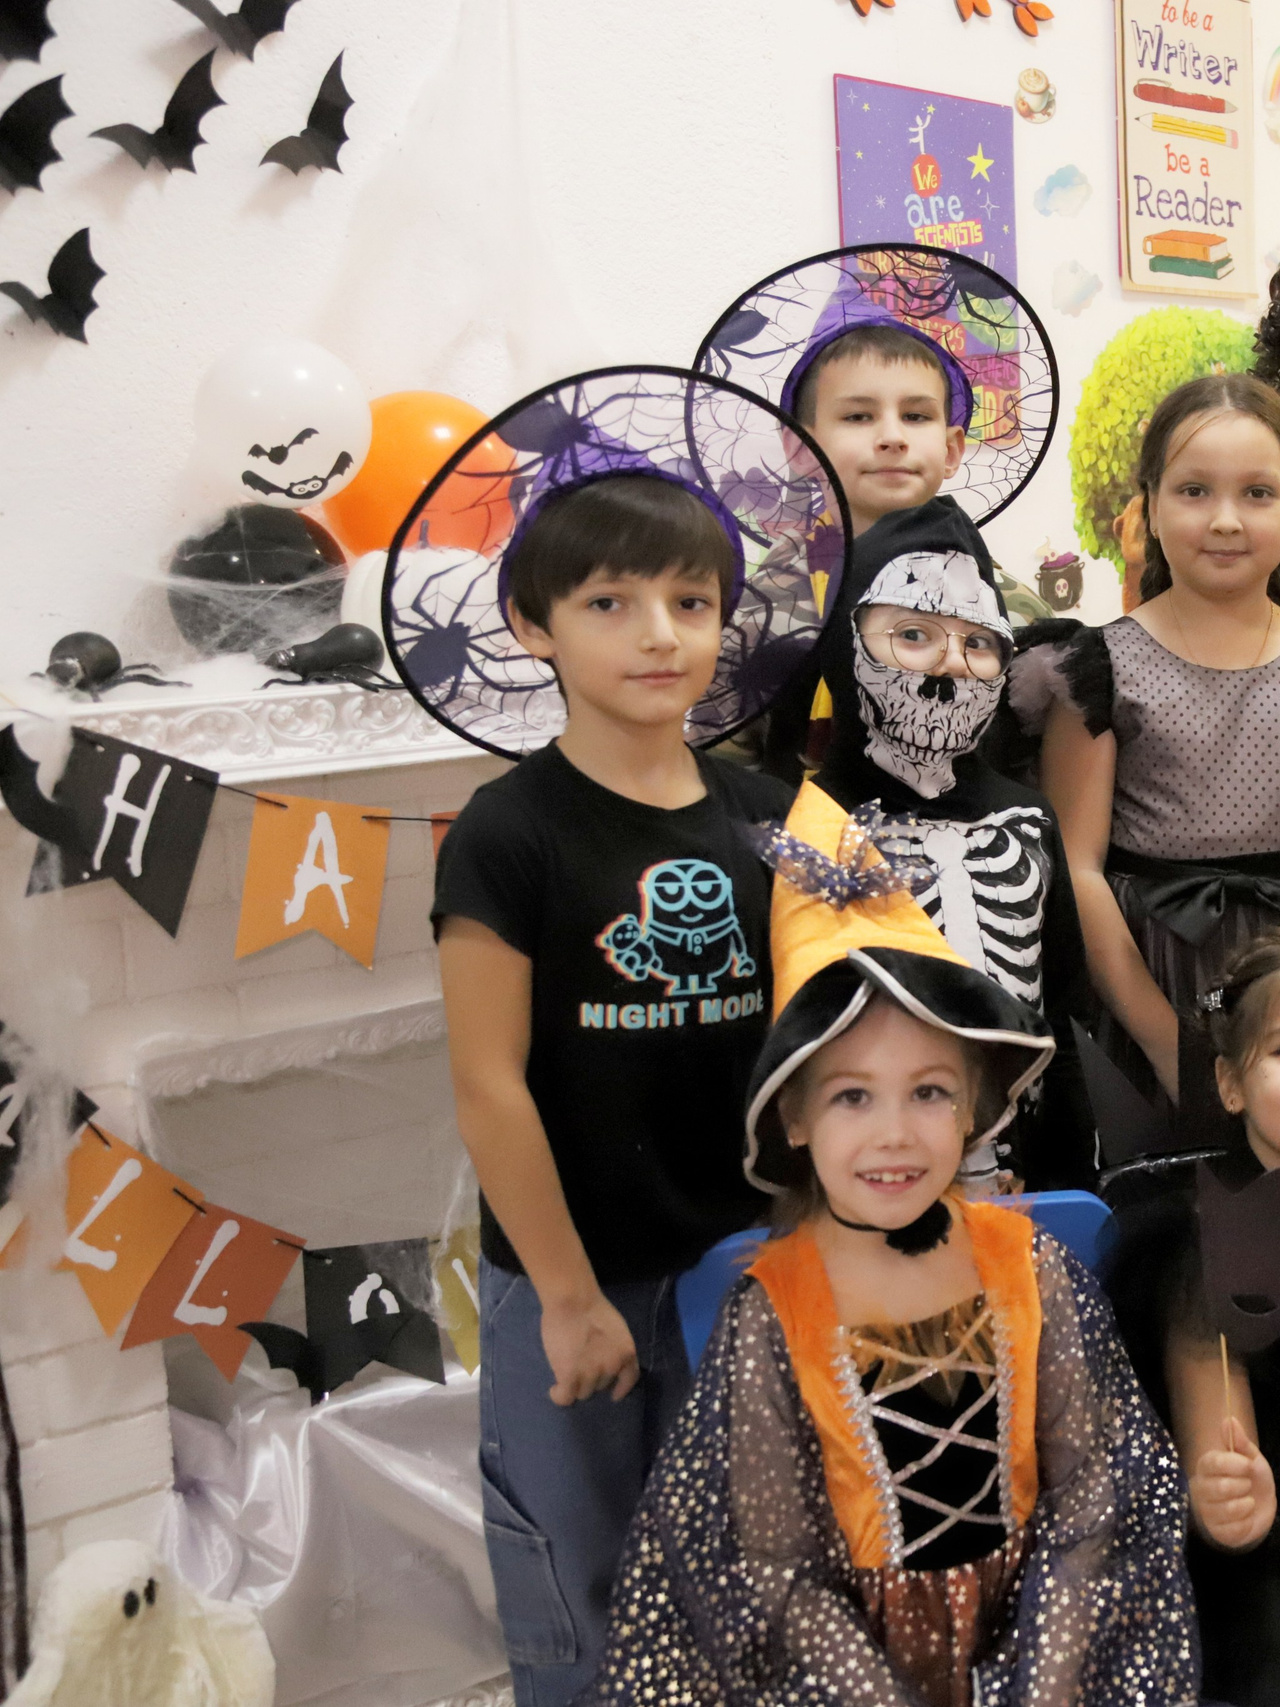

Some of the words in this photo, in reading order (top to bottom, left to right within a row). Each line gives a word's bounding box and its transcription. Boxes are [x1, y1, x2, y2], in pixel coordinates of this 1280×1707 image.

[1162, 0, 1178, 22] to
[1182, 0, 1198, 28] be
[1203, 14, 1214, 31] a
[1131, 20, 1238, 86] Writer
[913, 163, 938, 190] We
[1165, 143, 1191, 174] be
[1200, 157, 1211, 177] a
[904, 193, 964, 228] are
[1133, 175, 1242, 227] Reader
[579, 1001, 690, 1029] NIGHT
